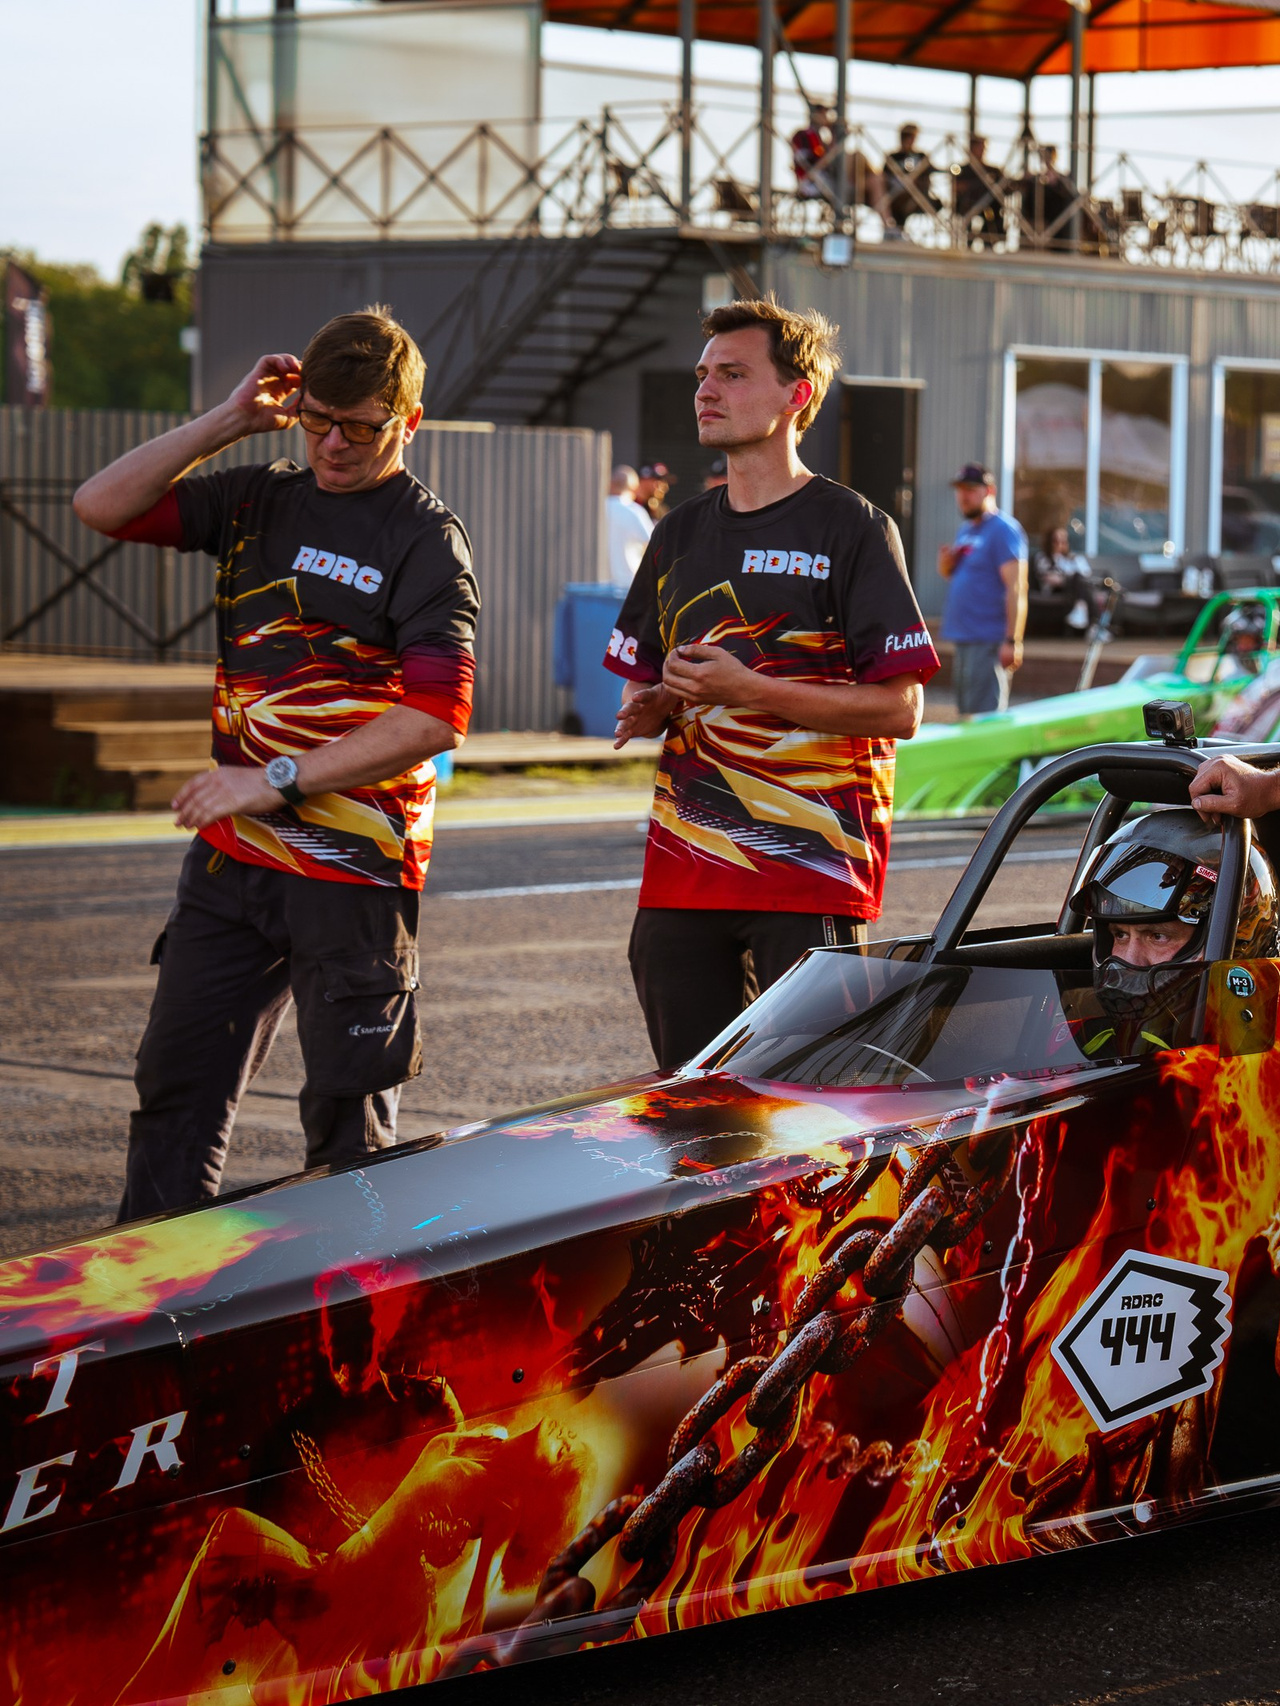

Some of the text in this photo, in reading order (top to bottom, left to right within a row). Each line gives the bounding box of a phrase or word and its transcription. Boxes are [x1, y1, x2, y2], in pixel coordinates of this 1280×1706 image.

[291, 545, 383, 595] RDRC
[742, 549, 831, 580] RDRC
[607, 628, 638, 666] RC
[885, 630, 932, 653] FLAM
[1199, 867, 1217, 881] SIMPS
[1232, 976, 1248, 986] M-3
[376, 1024, 397, 1034] RAC
[1121, 1293, 1163, 1310] RDRC
[1100, 1312, 1176, 1366] 444
